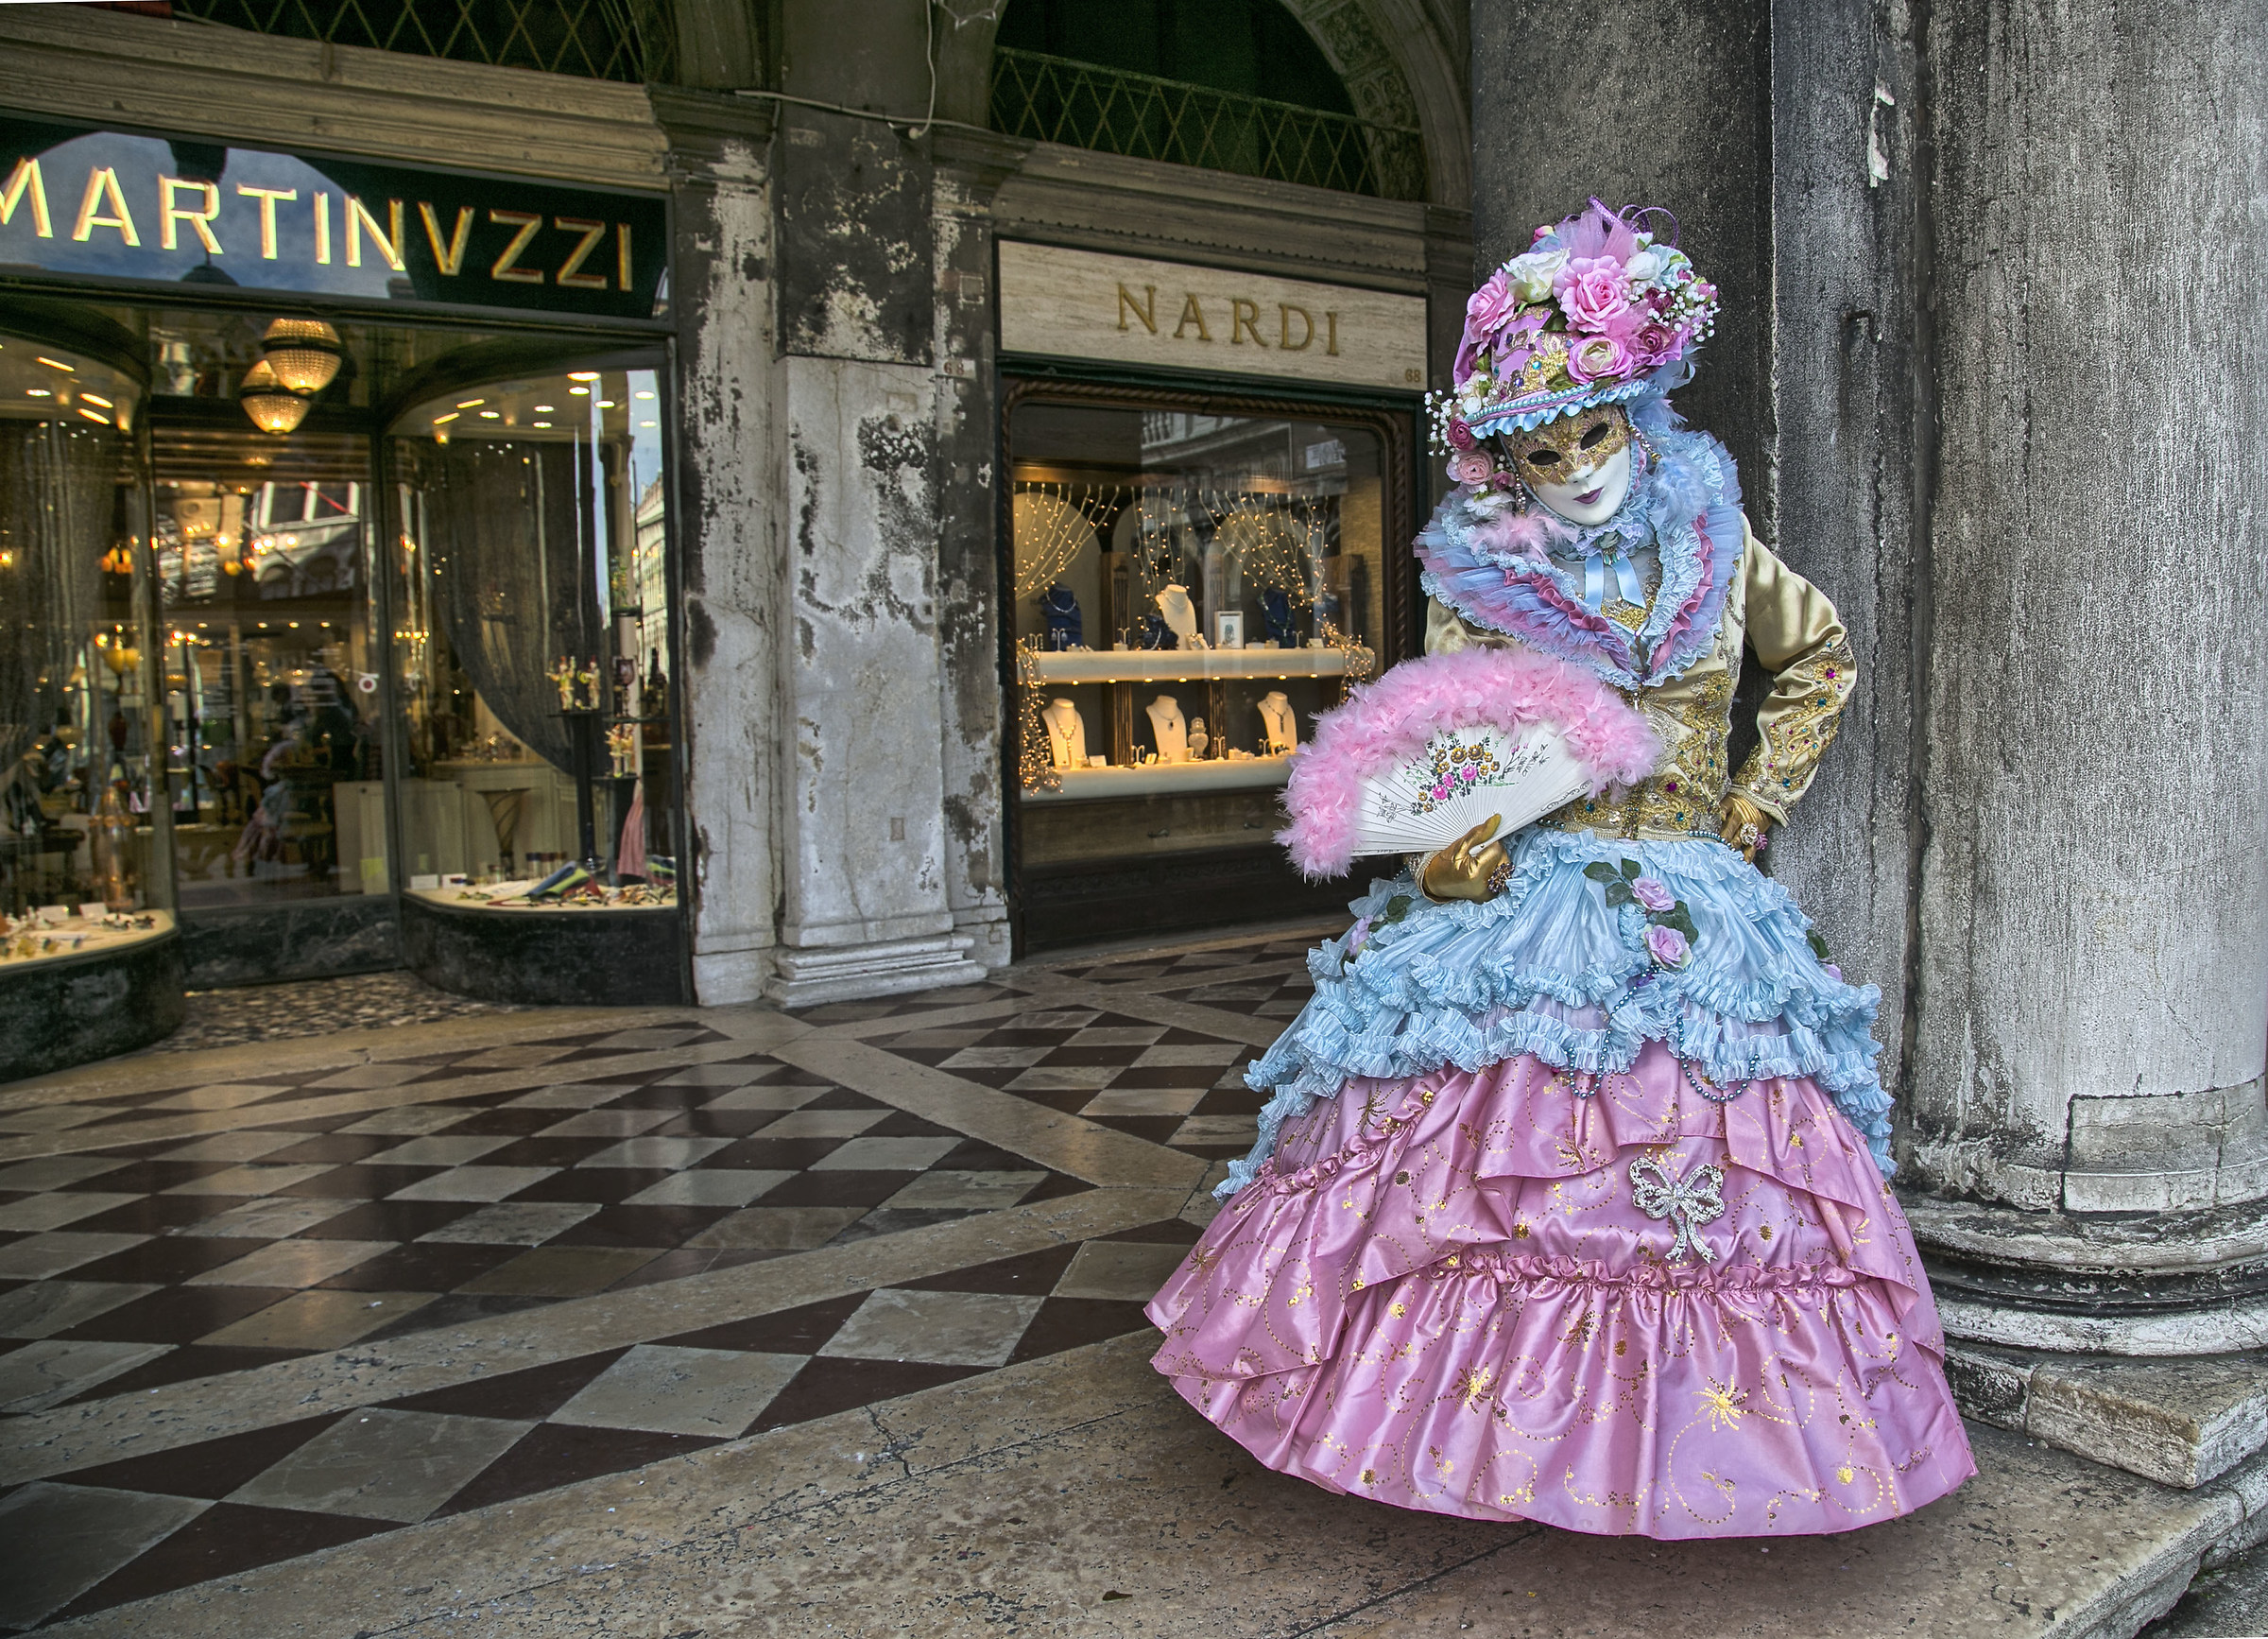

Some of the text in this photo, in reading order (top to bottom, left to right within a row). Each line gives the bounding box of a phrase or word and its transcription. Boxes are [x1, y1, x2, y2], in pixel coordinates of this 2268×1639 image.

[1117, 282, 1339, 356] NARDI
[943, 361, 966, 375] 68
[1404, 368, 1422, 383] 68
